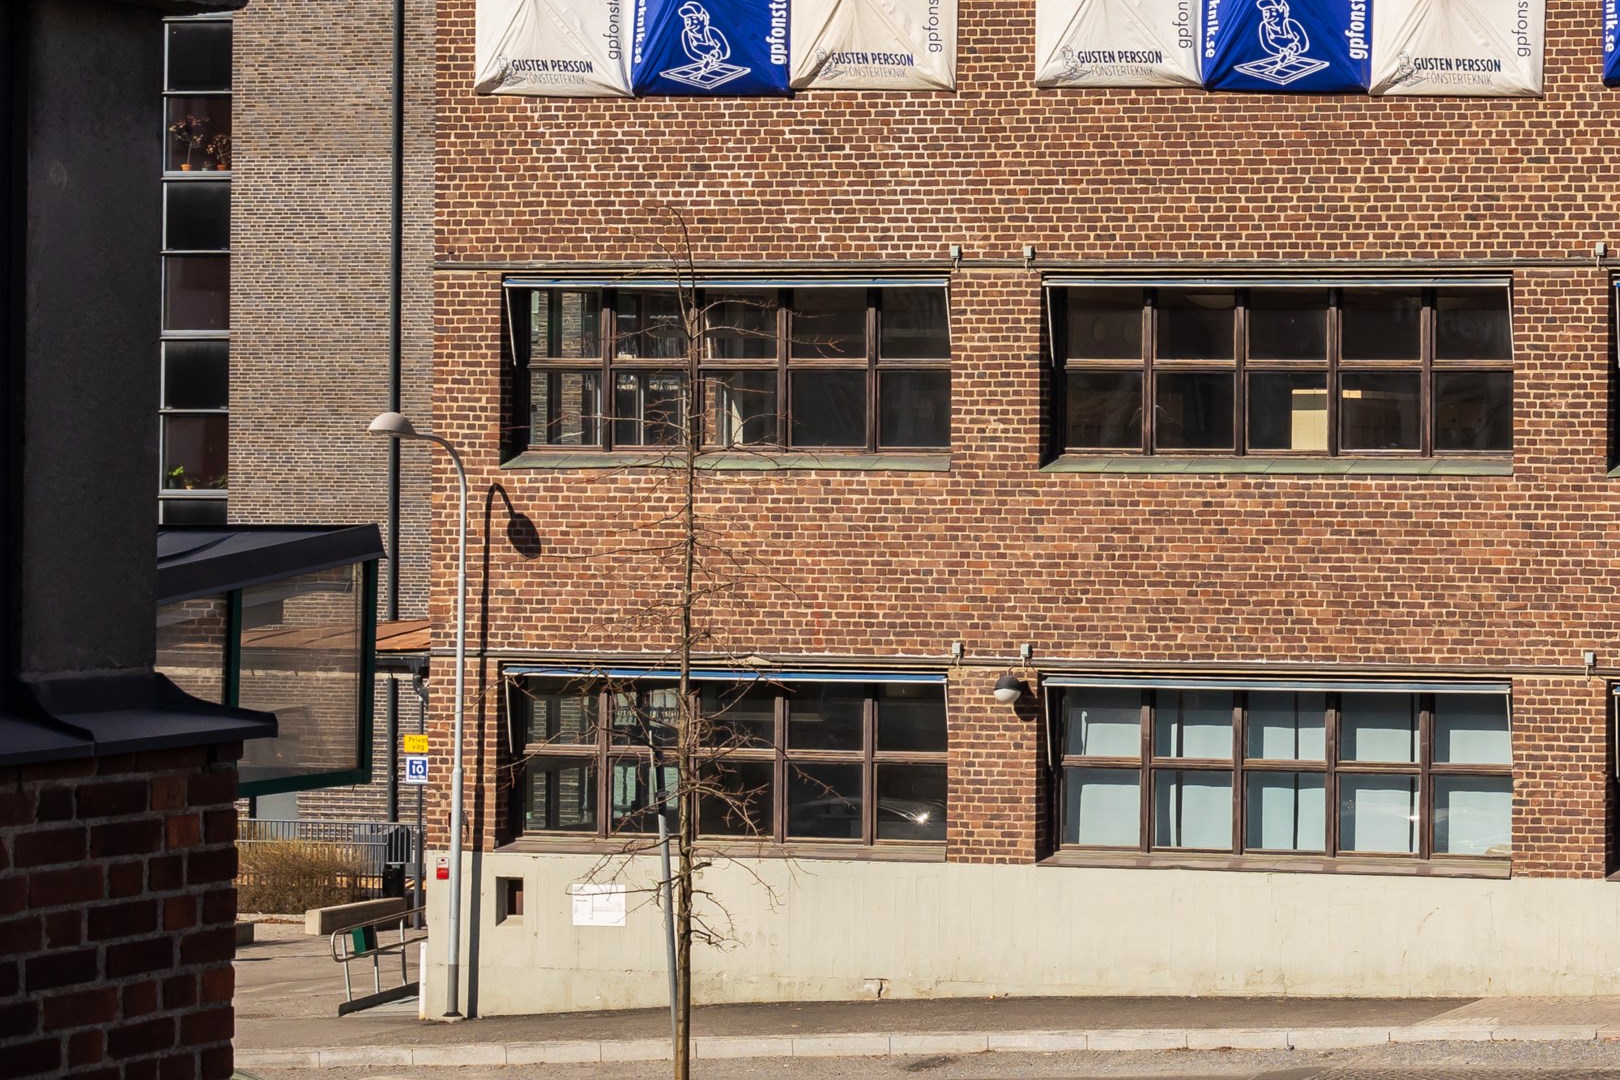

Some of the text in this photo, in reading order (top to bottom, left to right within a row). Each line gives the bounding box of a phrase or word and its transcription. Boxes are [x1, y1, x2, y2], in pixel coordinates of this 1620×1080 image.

[831, 52, 915, 67] GUSTEN PERSSON
[1077, 50, 1163, 64] GUSTEN PERSSON
[511, 59, 594, 73] GUSTEN PERSSON
[1413, 57, 1501, 72] GUSTEN PERSSON
[412, 764, 424, 774] 10
